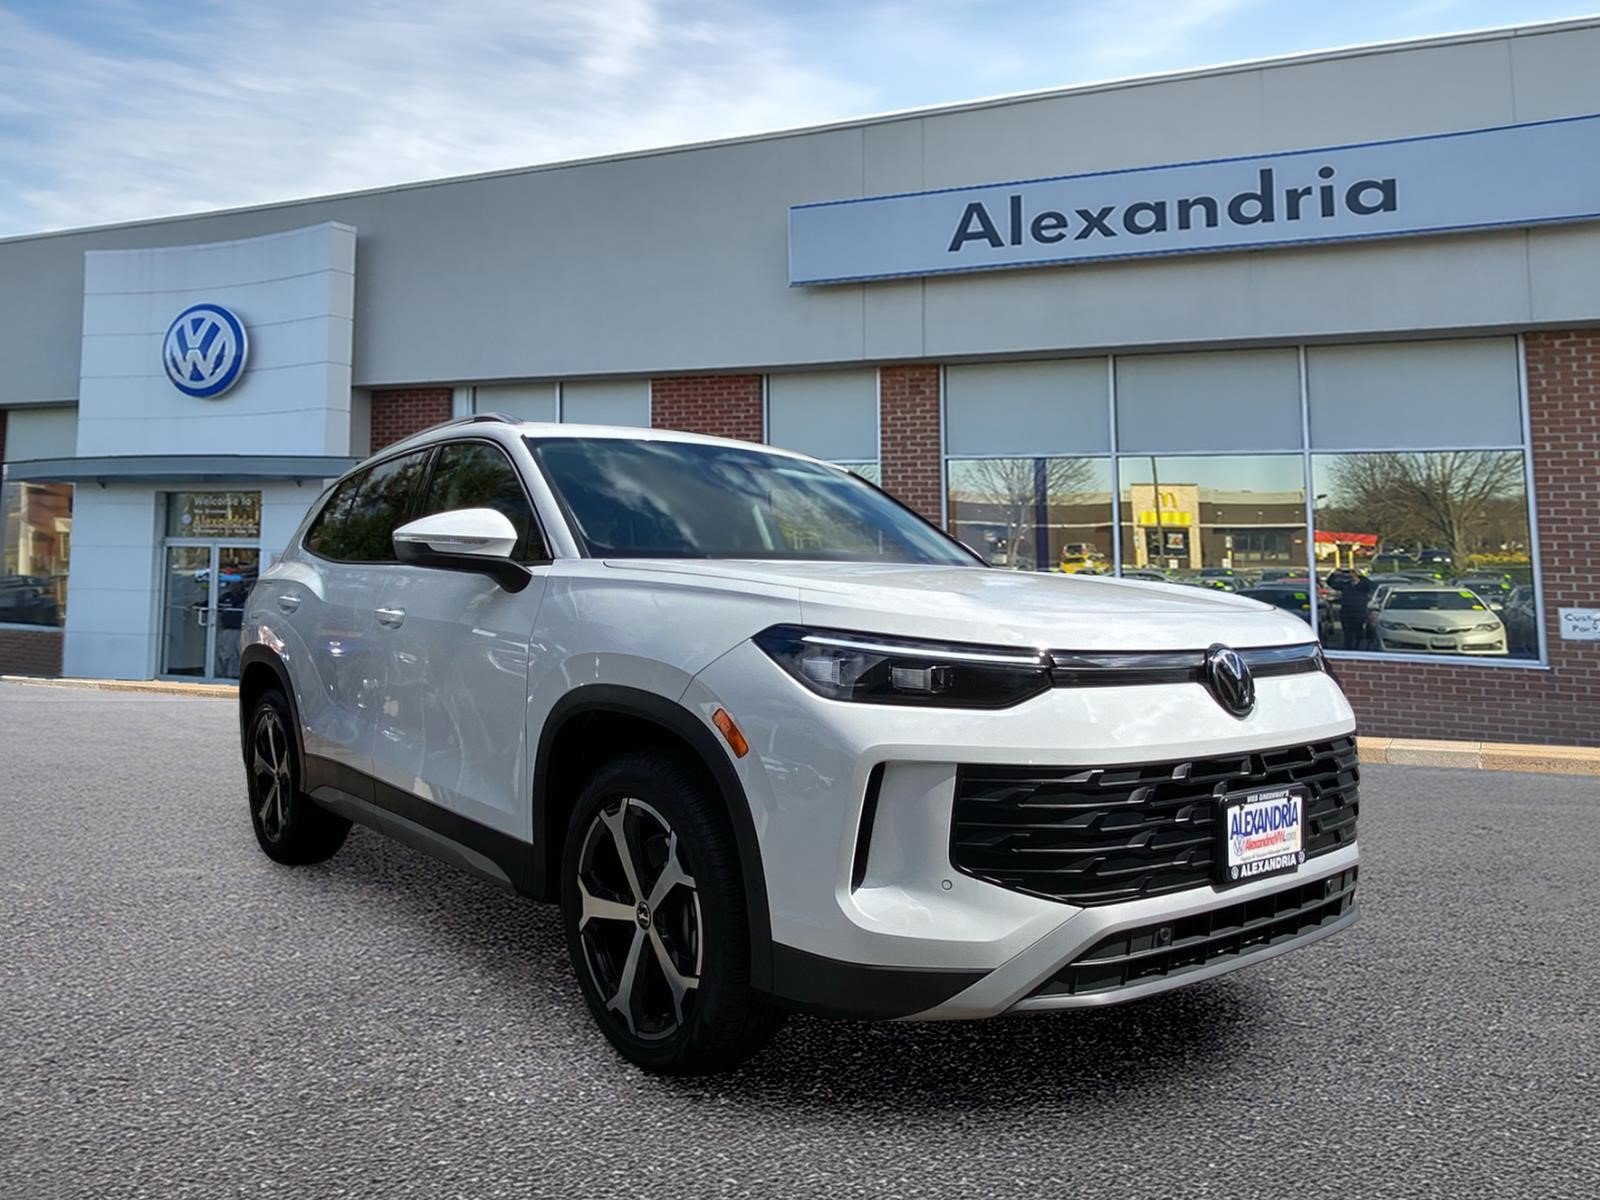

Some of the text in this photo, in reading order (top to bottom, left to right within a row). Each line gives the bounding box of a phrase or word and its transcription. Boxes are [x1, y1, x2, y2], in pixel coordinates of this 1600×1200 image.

[947, 165, 1398, 252] Alexandria
[166, 308, 240, 390] VW
[1230, 801, 1299, 840] ALEXANDRIA
[1240, 853, 1297, 878] ALEXANDRIA
